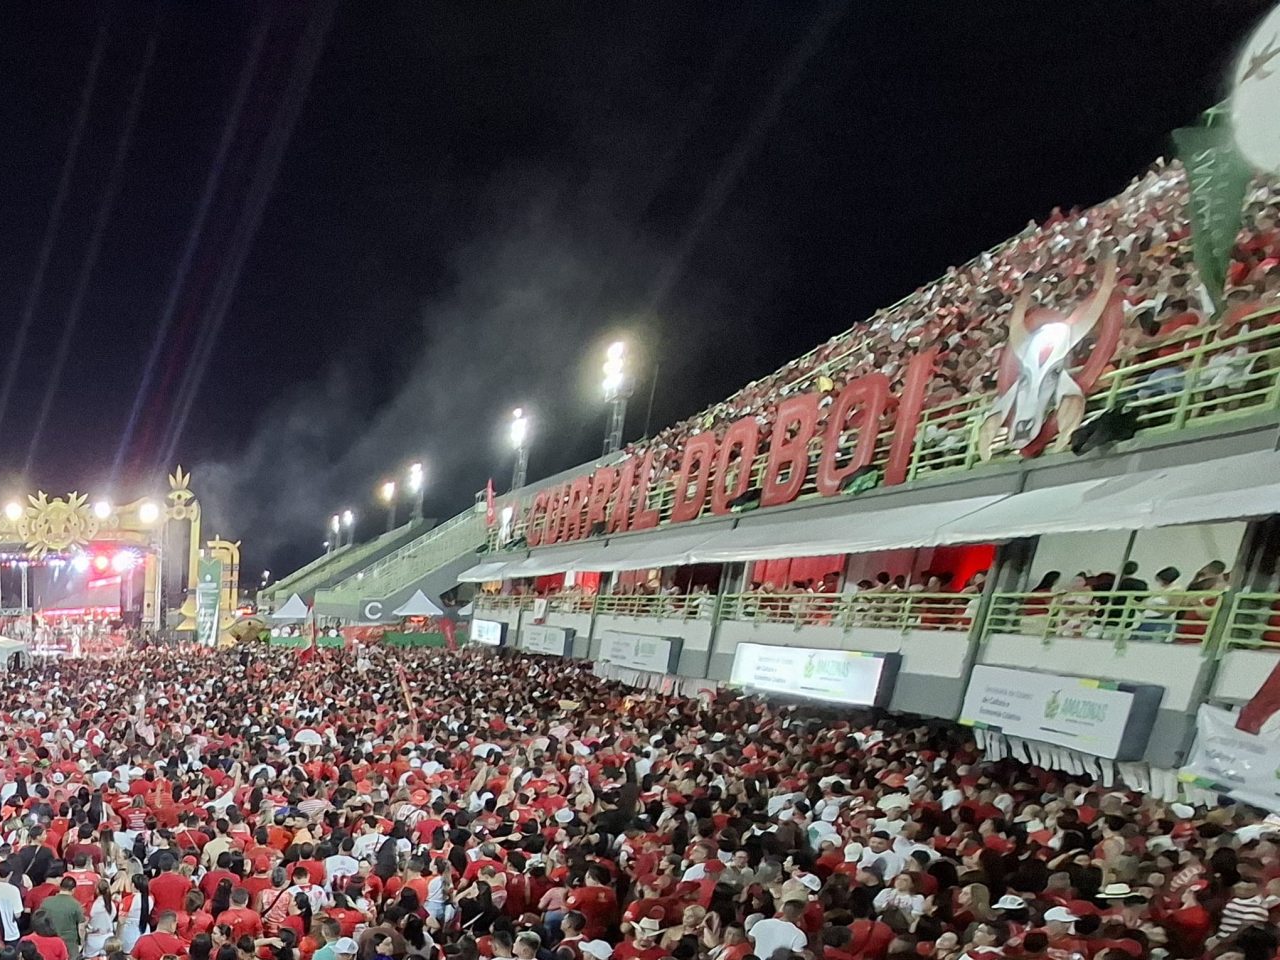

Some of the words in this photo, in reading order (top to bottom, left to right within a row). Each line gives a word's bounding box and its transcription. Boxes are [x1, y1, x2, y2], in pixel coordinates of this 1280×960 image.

[526, 450, 660, 547] CURRAL
[671, 415, 760, 522] DO
[760, 346, 940, 507] BOI
[364, 602, 383, 619] C
[1060, 697, 1108, 722] AMAZONAS
